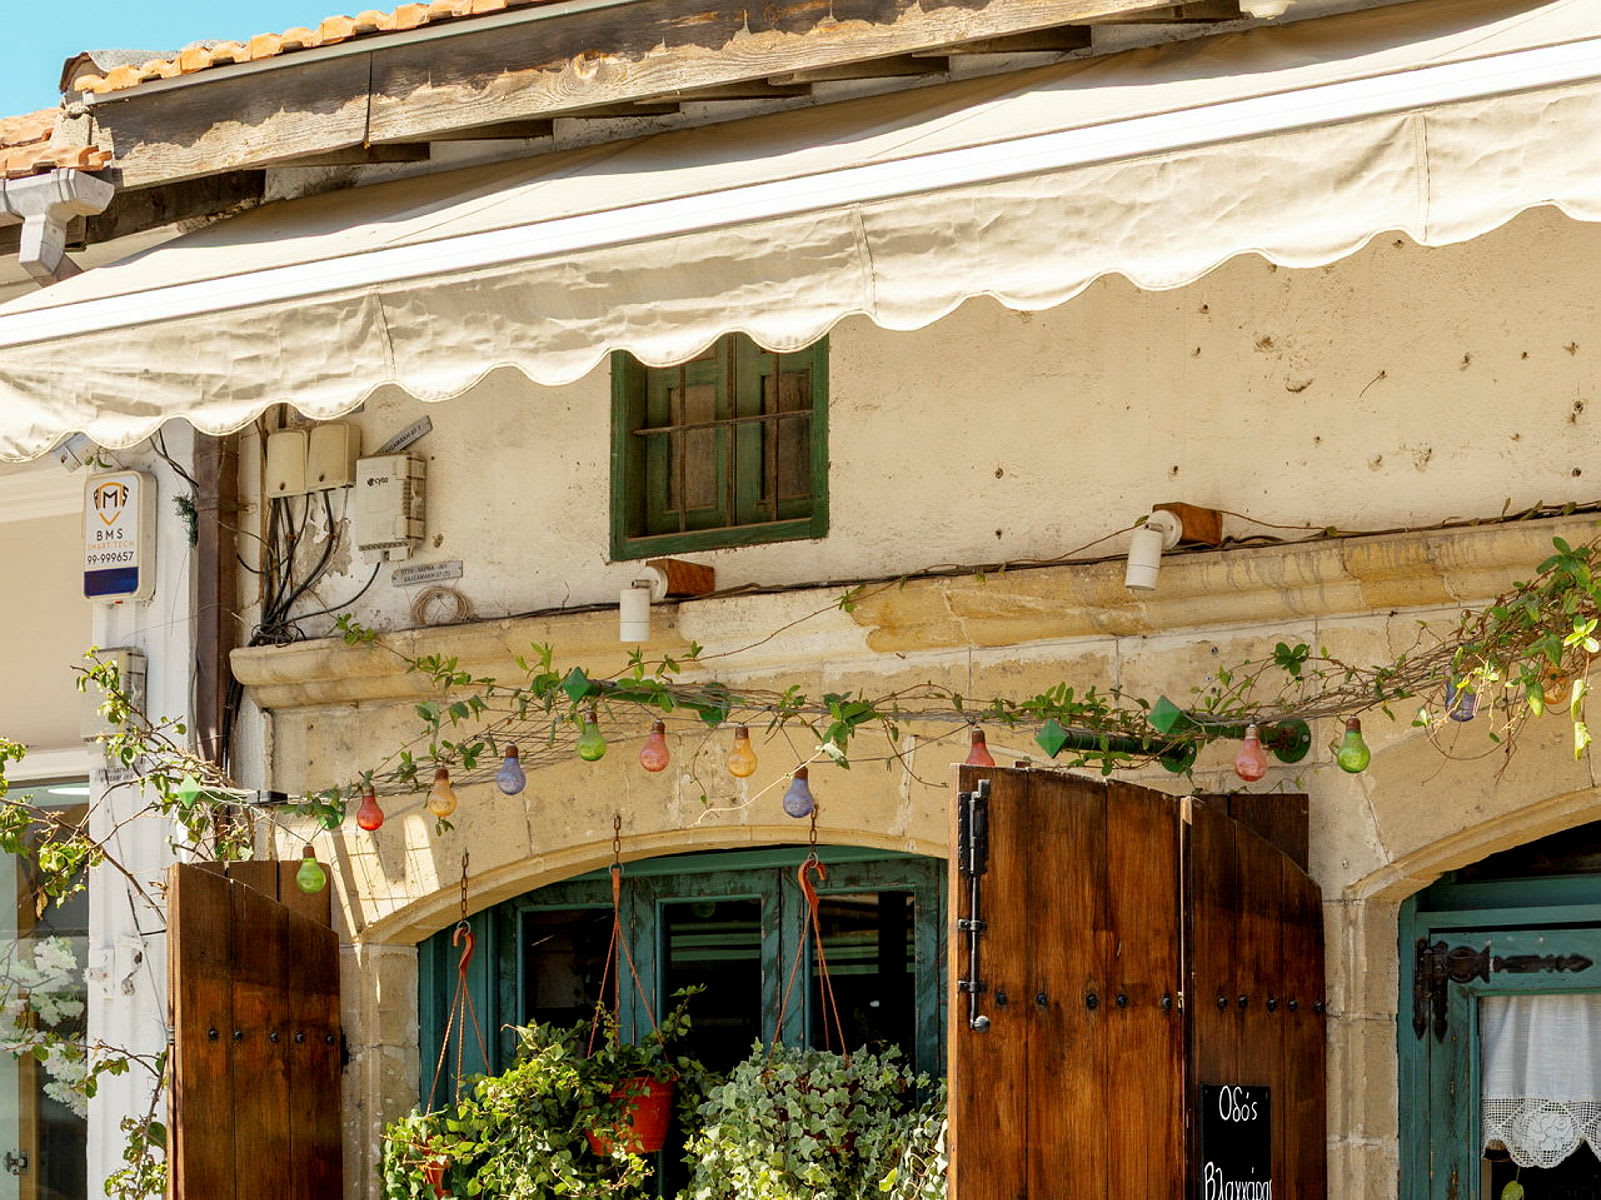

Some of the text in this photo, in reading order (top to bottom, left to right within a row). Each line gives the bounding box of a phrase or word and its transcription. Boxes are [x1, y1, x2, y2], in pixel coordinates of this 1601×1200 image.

[96, 528, 123, 541] BMS
[87, 551, 135, 566] 99-999657
[1218, 1085, 1258, 1122] Οδός
